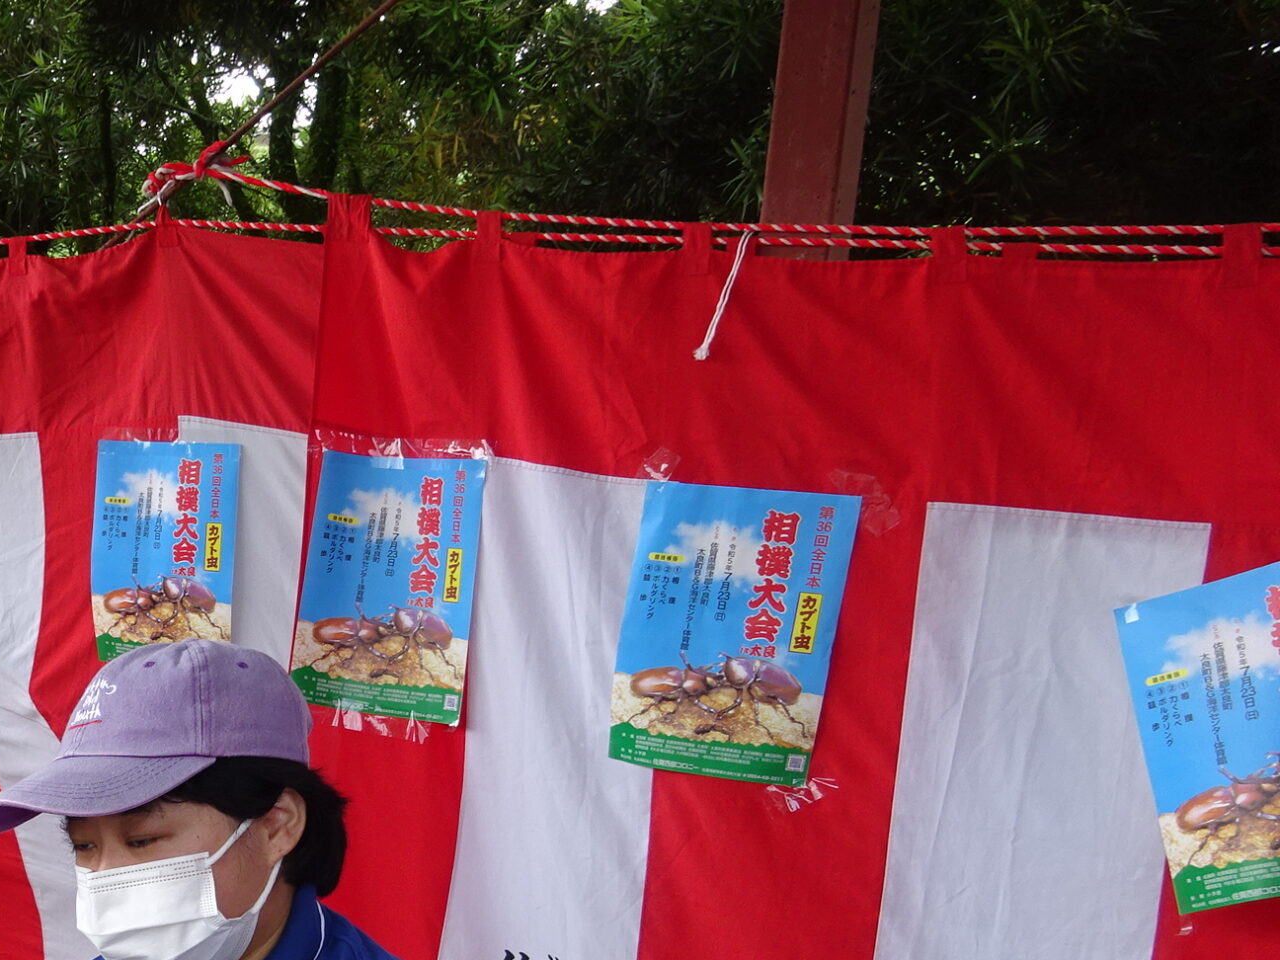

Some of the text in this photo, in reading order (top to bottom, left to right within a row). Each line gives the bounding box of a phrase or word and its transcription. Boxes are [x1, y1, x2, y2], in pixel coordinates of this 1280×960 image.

[172, 459, 202, 564] 相撲大会
[210, 453, 225, 519] 第36回全日本
[450, 470, 467, 543] 第36回全日本
[206, 525, 220, 569] カブト虫
[409, 476, 444, 595] 相撲大会
[804, 506, 836, 588] 第36回全日本
[445, 550, 461, 600] カブト虫
[744, 510, 801, 644] 相撲大会
[792, 595, 819, 651] カブト虫
